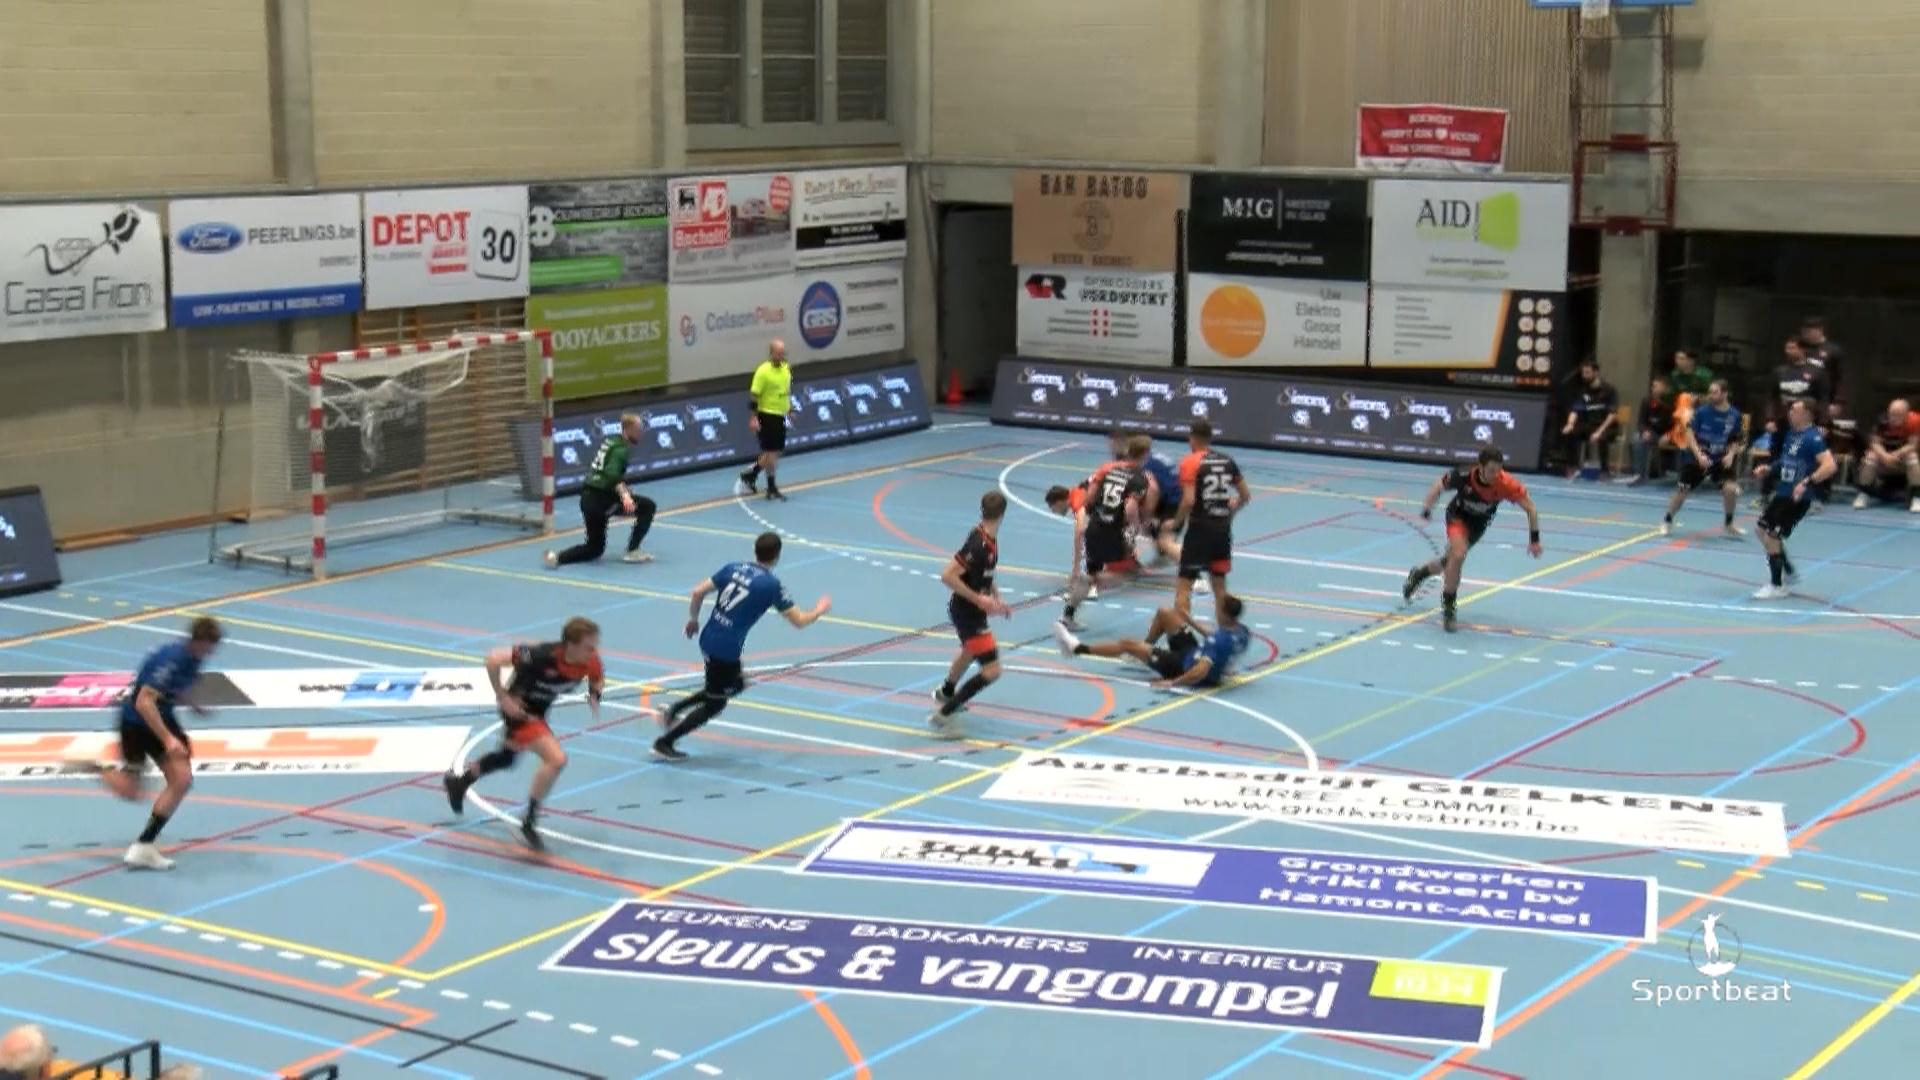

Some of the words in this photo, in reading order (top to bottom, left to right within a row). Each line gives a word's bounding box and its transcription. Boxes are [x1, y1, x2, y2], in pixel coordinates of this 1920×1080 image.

[1040, 174, 1075, 195] BAR
[1222, 196, 1274, 219] MIG
[248, 224, 356, 245] PEERLINGS.be
[372, 211, 471, 247] DEPOT
[481, 226, 517, 264] 30
[5, 281, 86, 316] Casa
[1296, 303, 1341, 317] Elektro
[1294, 335, 1341, 350] Handel
[1304, 319, 1342, 333] Groot
[1102, 482, 1126, 507] 15
[1203, 474, 1239, 500] 25
[1028, 757, 1378, 790] Autobedrijf
[1407, 781, 1764, 817] GIELKENS
[1238, 785, 1341, 802] BREE
[1379, 796, 1546, 818] LOMMEL
[1182, 797, 1580, 834] www.gielkensbree.be
[1278, 856, 1586, 892] Grondwerken
[1259, 887, 1593, 928] Hamont-Achel
[1394, 879, 1510, 901] Koen
[1522, 888, 1579, 906] bv
[634, 908, 813, 932] KEUKENS
[850, 924, 1089, 954] BADKAMERS
[1132, 944, 1345, 976] INTERIEUR
[592, 928, 827, 976] sleurs
[840, 945, 897, 982] &
[920, 955, 1339, 1020] vangompel
